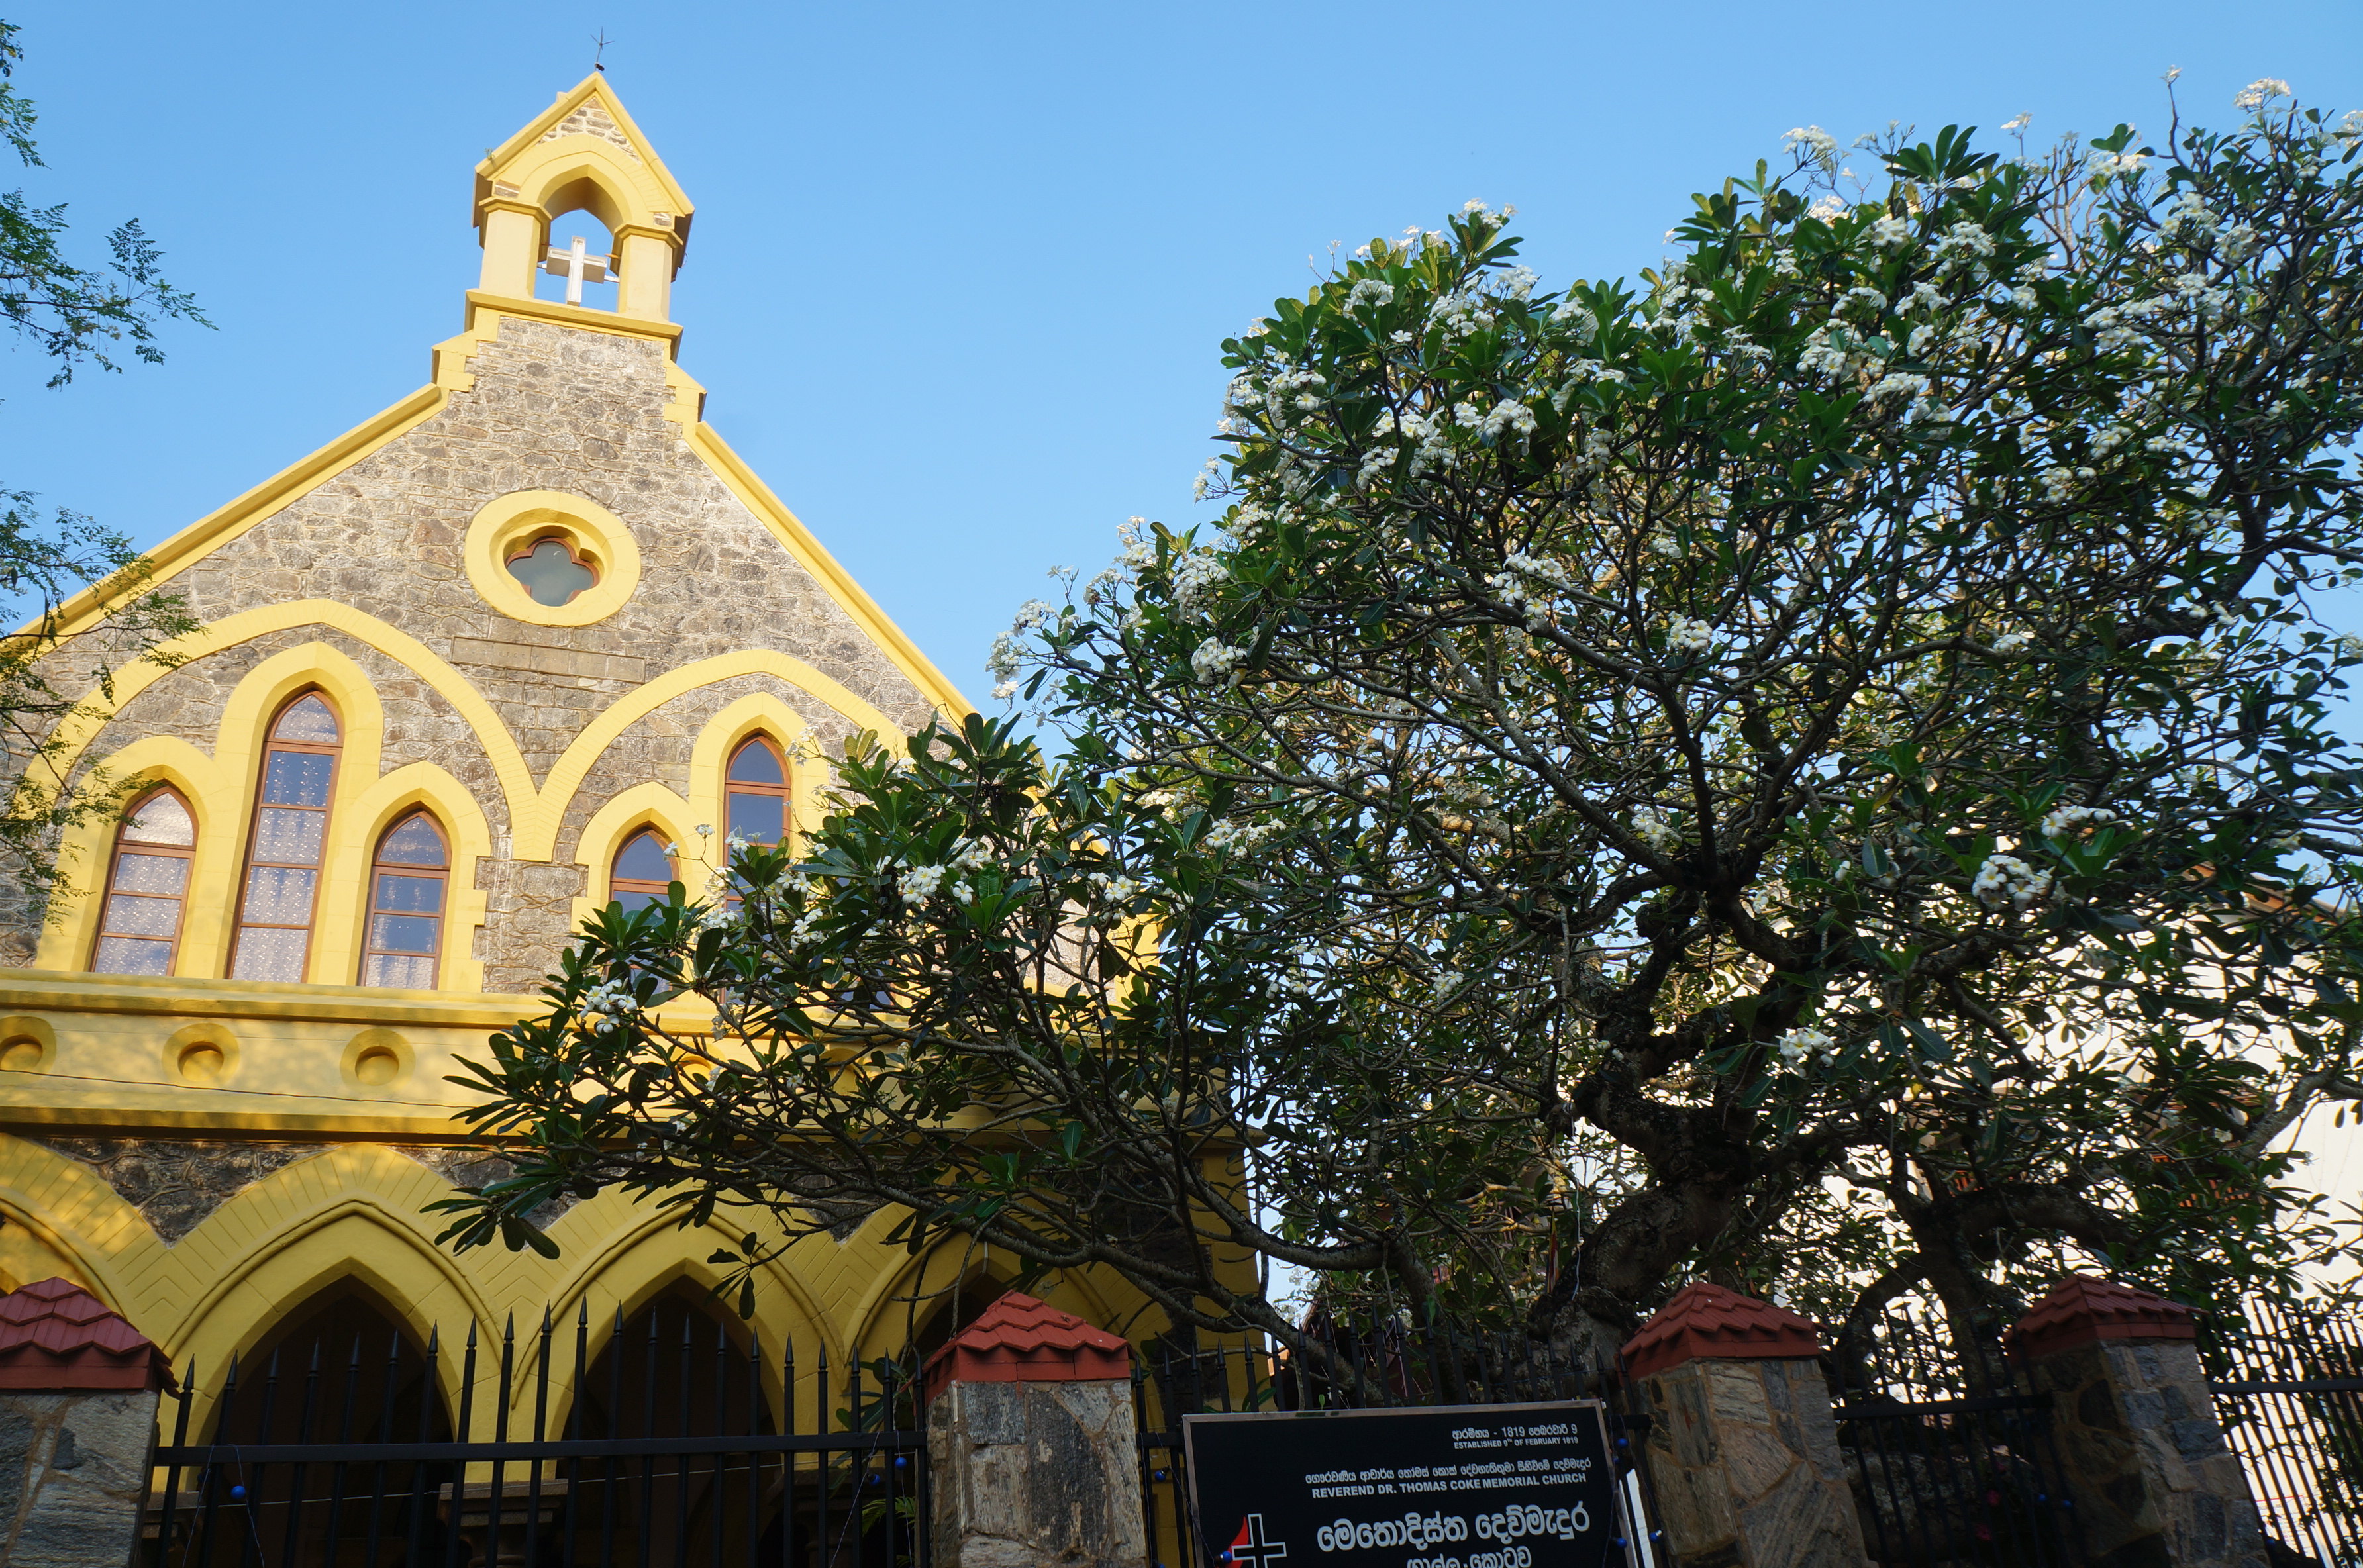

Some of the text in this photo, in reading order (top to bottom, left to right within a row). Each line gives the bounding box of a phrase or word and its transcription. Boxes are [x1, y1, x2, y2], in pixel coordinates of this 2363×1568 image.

[1501, 1426, 1525, 1438] 1819
[1571, 1424, 1578, 1434] 9
[1454, 1440, 1502, 1449] ESTABLISHED
[1525, 1437, 1561, 1446] FEBRUARY
[1311, 1473, 1587, 1499] REVEREND DR. THOMAS COKE MEMORIAL CHURCH
[1475, 1500, 1591, 1544] දෙව්මැදුර
